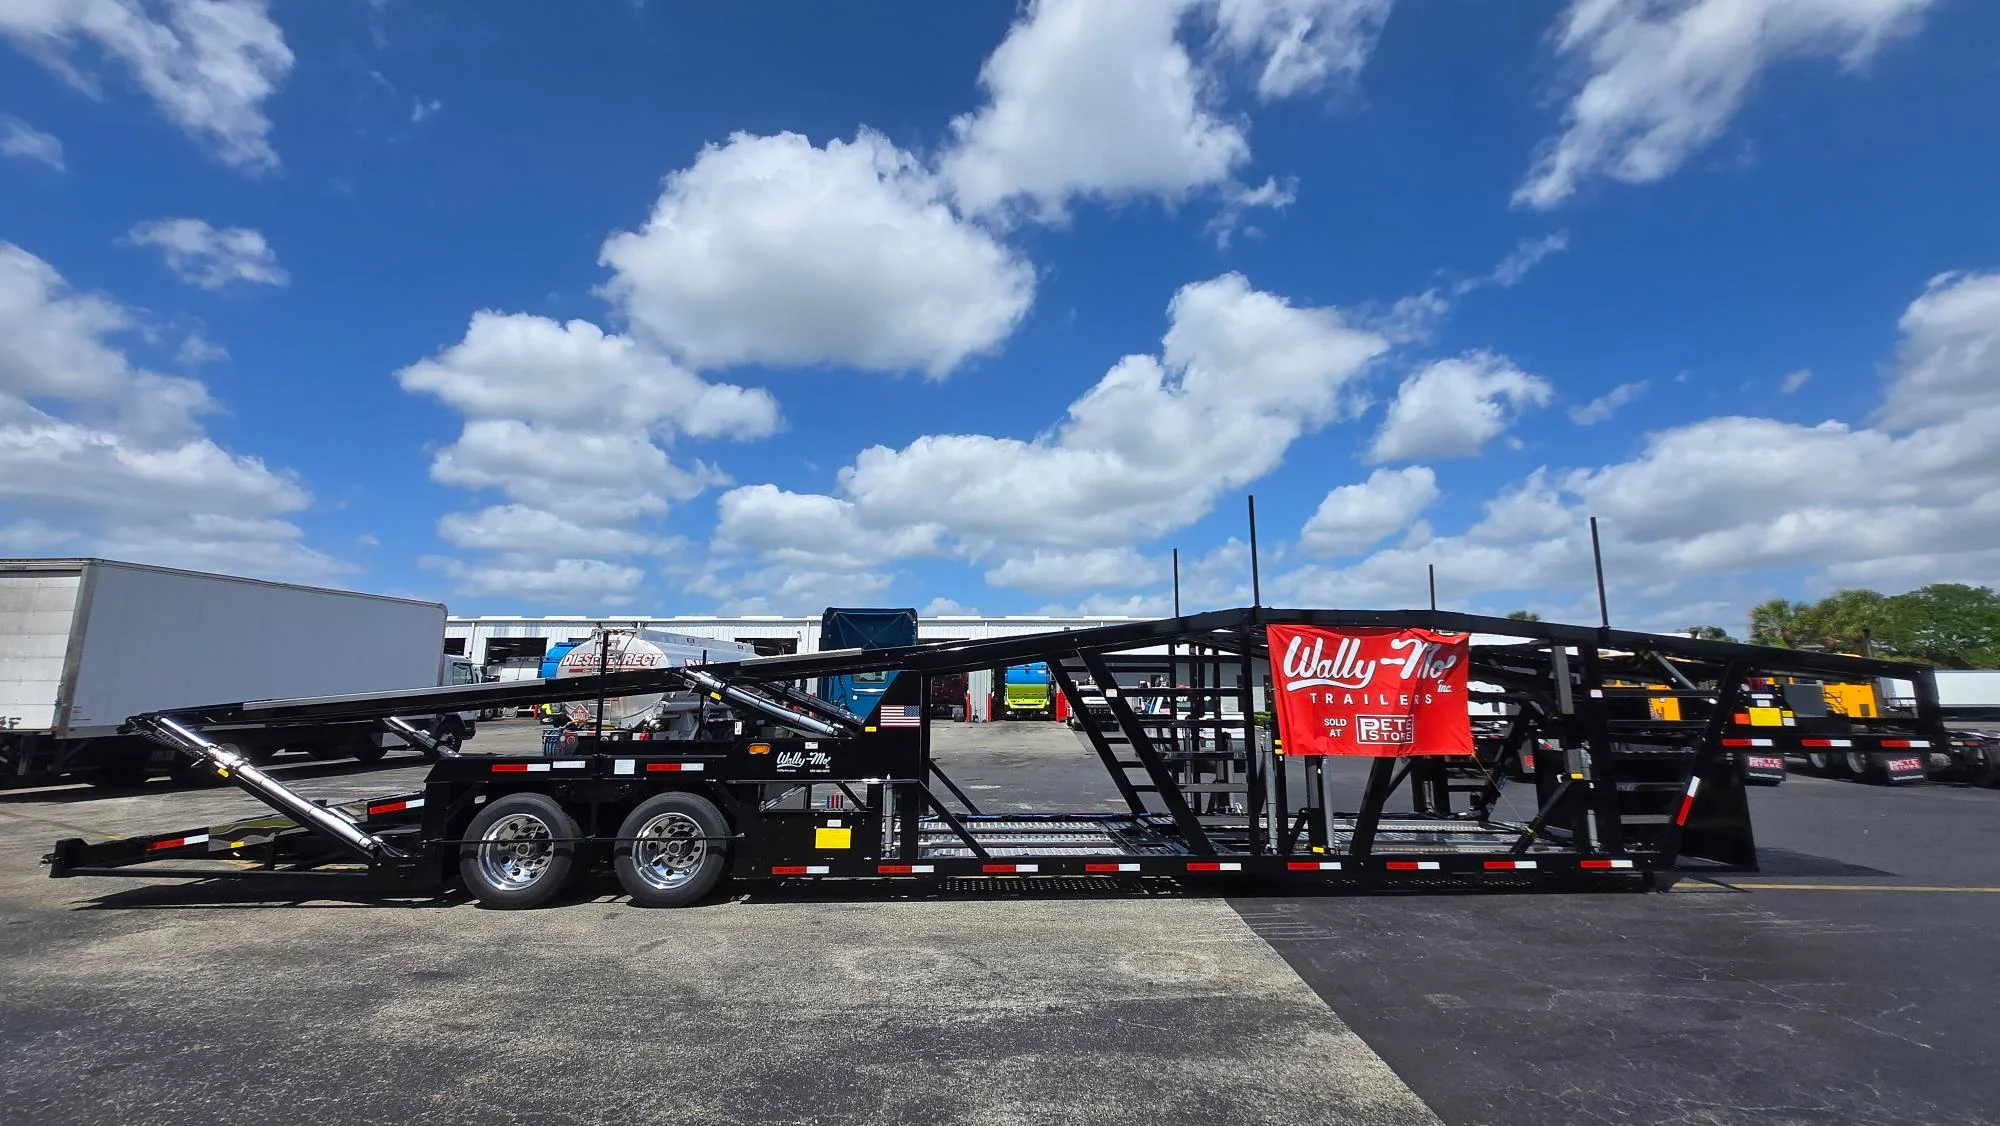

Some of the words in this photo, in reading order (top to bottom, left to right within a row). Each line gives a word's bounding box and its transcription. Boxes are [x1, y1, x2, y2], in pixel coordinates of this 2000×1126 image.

[1310, 693, 1432, 705] TRAILERS
[1324, 718, 1347, 727] SOLD
[1329, 729, 1342, 737] AT
[1360, 718, 1412, 740] PETE
[1369, 730, 1412, 740] STORE
